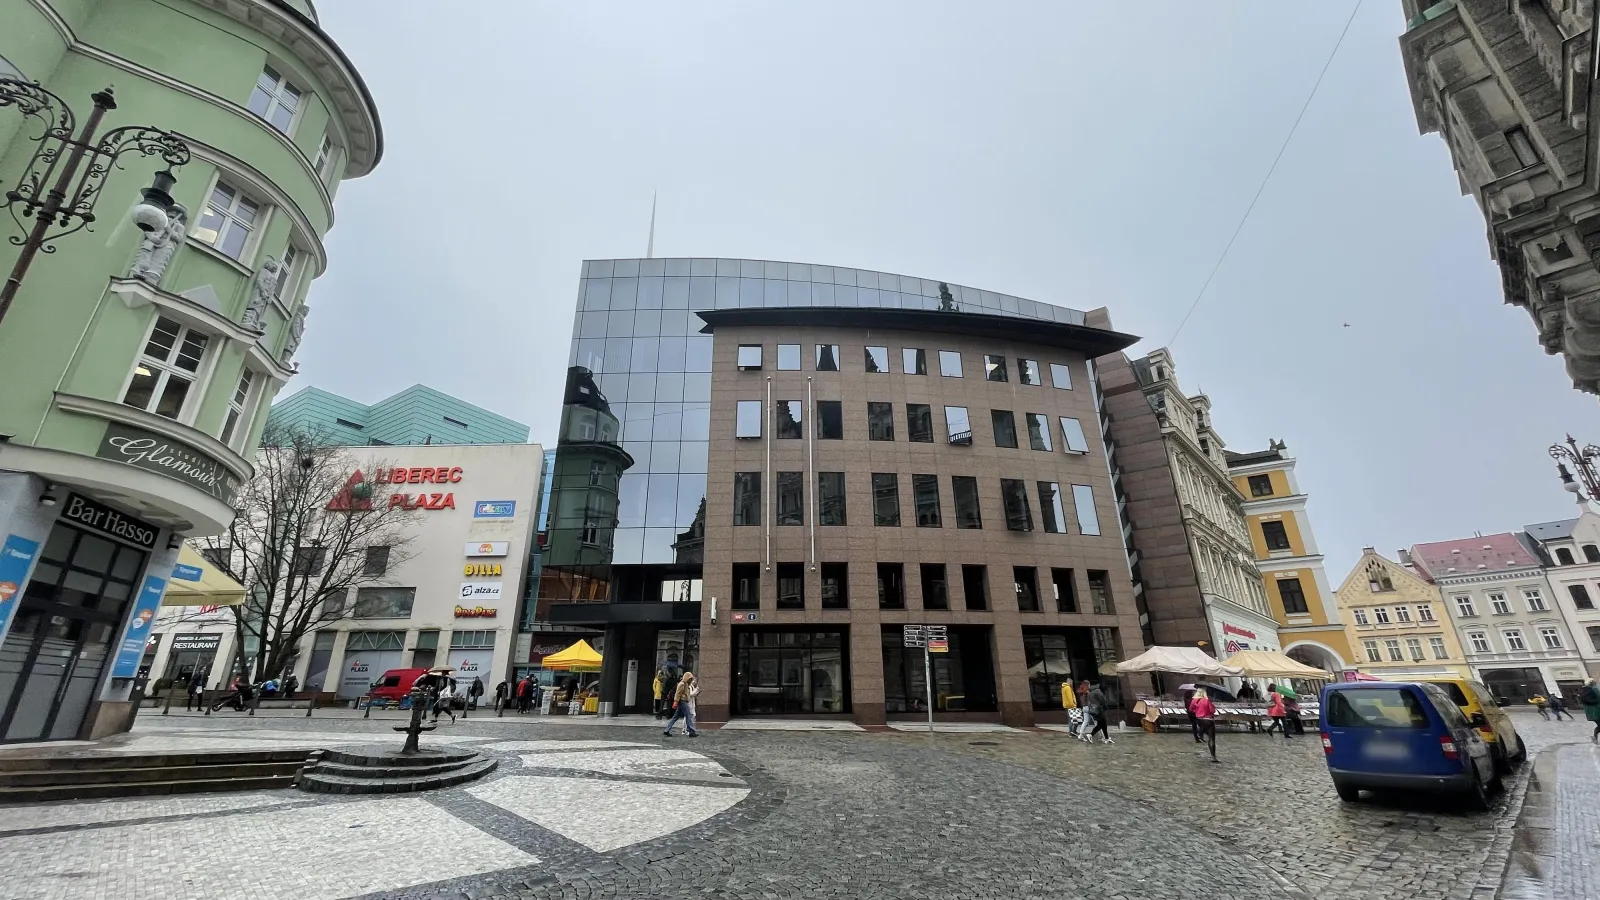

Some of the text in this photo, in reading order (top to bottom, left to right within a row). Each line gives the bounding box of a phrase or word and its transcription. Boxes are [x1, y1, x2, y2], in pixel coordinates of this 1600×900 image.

[109, 436, 217, 487] Glamour
[375, 466, 464, 484] LIBEREC
[387, 493, 456, 511] PLAZA
[67, 496, 153, 545] Bar Hasso
[464, 564, 502, 577] BILLA
[474, 586, 499, 595] alza.cz
